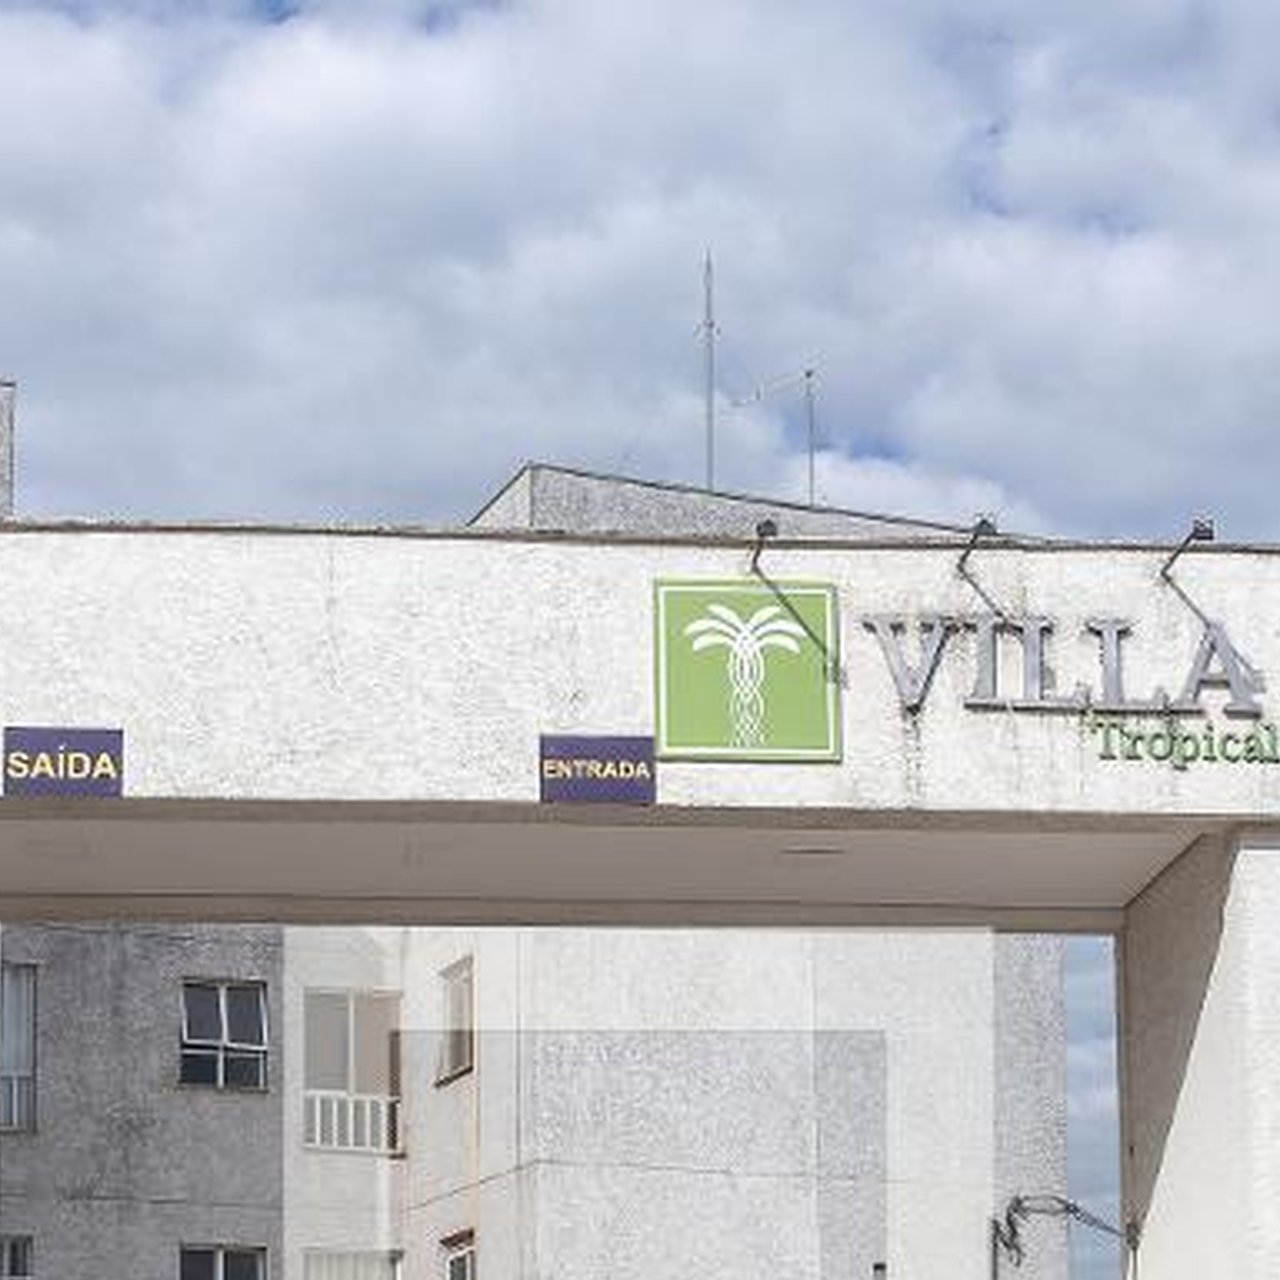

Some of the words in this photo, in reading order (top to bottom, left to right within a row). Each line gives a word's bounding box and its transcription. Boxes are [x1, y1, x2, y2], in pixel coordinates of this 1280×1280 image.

[862, 612, 1267, 718] VILLA
[6, 746, 117, 780] SAÍDA
[1091, 720, 1280, 769] Tropical
[542, 759, 651, 780] ENTRADA
